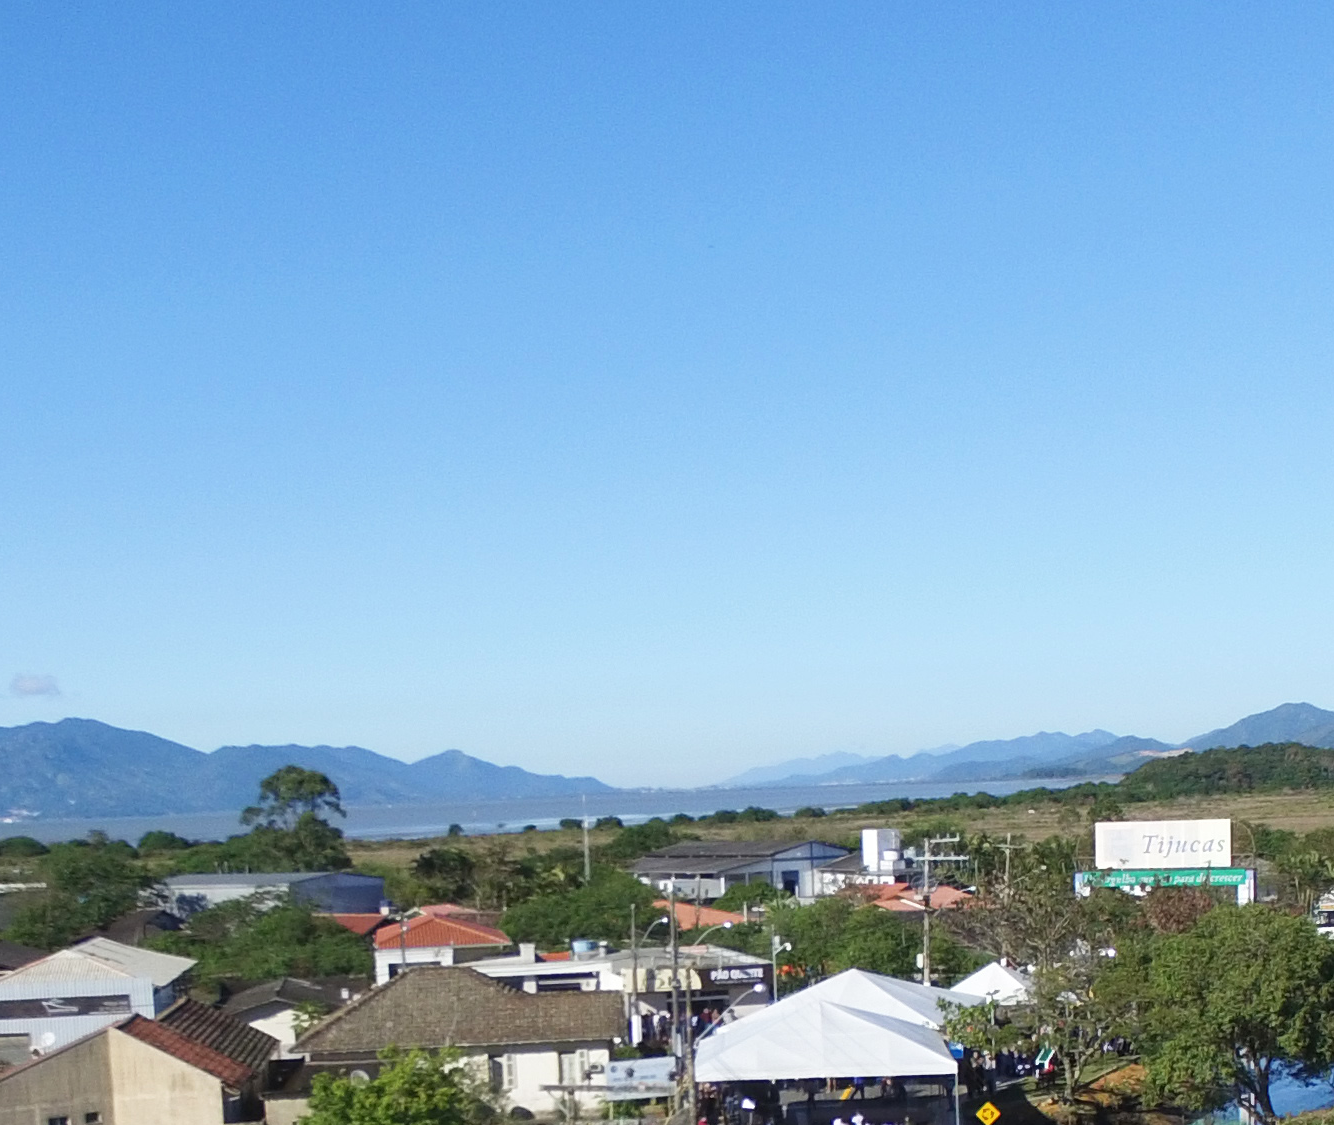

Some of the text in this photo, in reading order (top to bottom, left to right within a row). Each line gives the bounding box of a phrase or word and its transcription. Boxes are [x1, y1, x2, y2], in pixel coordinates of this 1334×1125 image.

[1142, 834, 1226, 858] Tijucas
[1101, 873, 1136, 887] rgulho
[1173, 874, 1194, 885] para
[1210, 874, 1243, 883] crescer
[710, 968, 729, 981] PÃO
